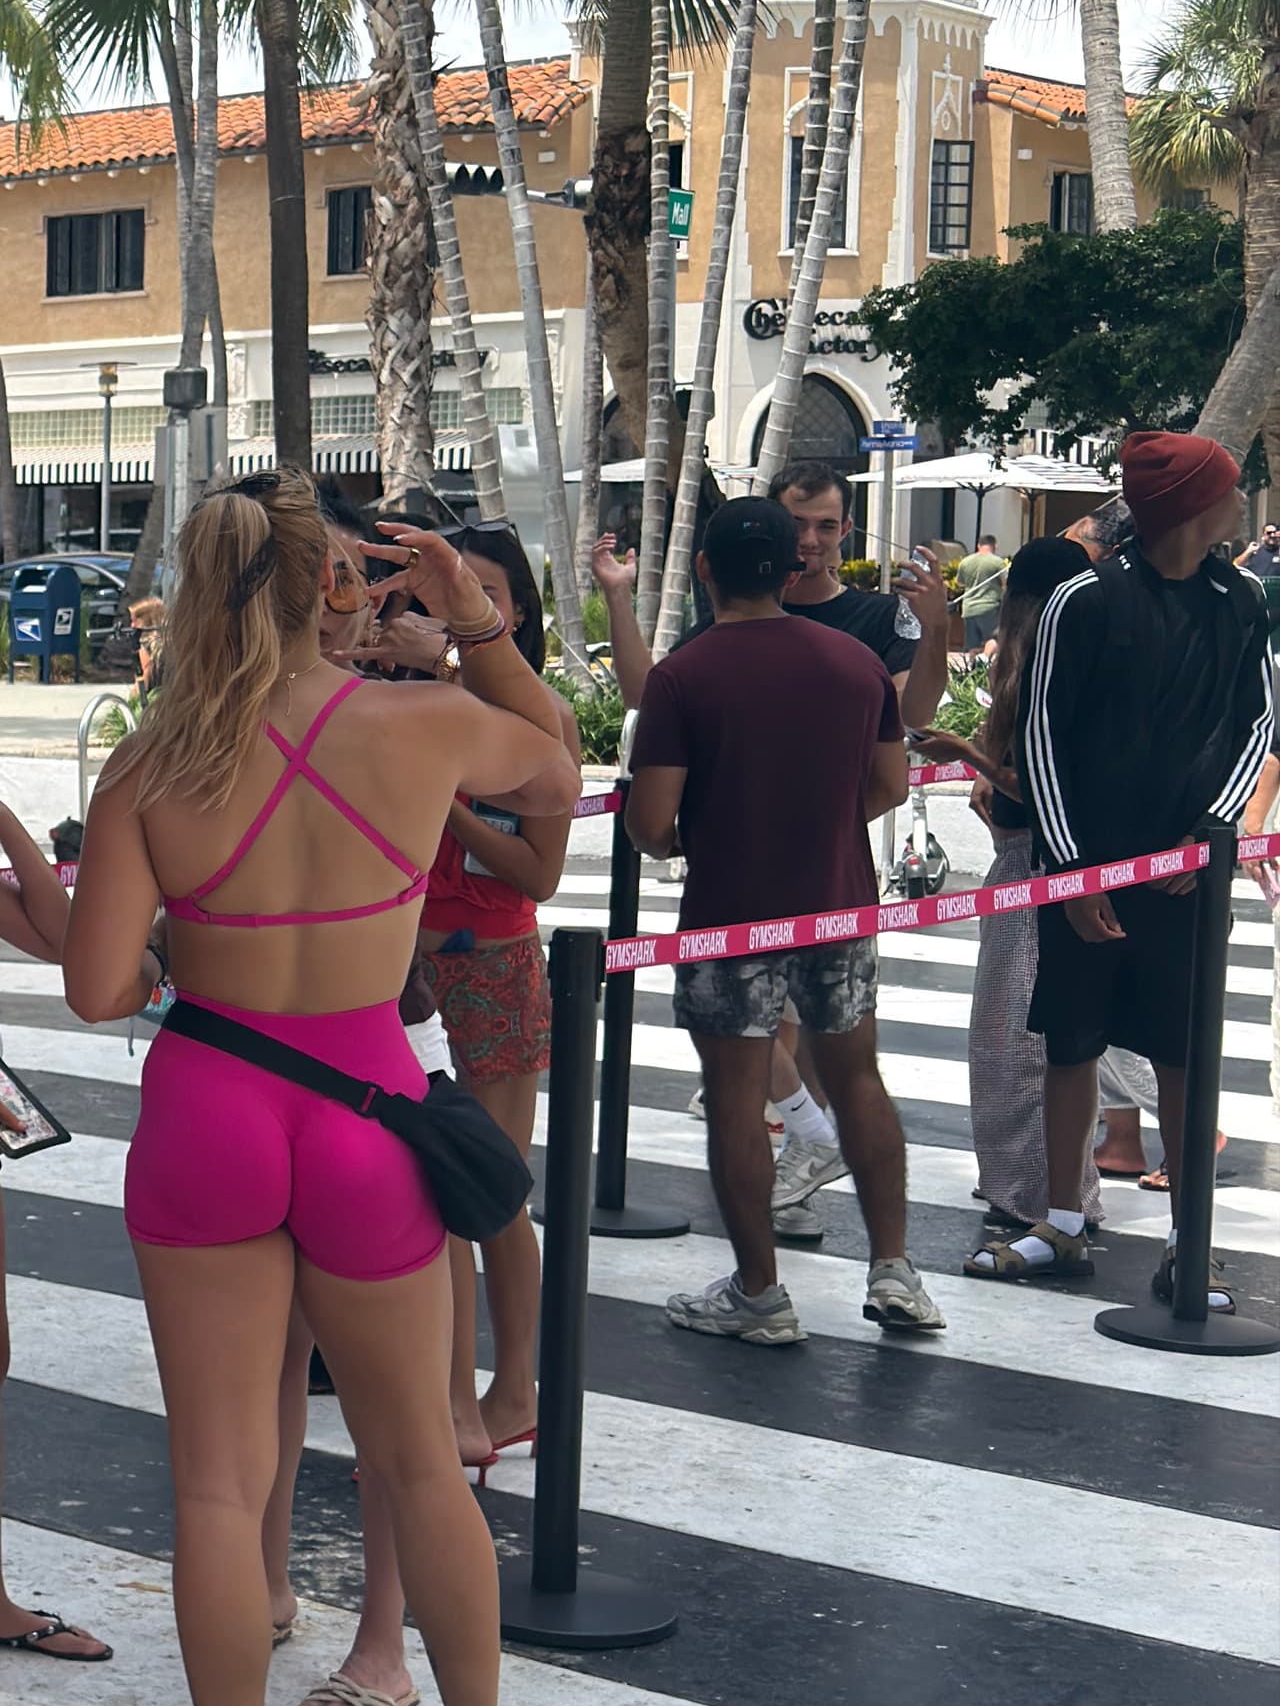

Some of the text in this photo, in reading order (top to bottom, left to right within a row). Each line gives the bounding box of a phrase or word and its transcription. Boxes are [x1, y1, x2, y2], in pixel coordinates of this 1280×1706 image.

[672, 201, 690, 226] Mall
[1238, 837, 1269, 859] GYMSHARK
[605, 939, 657, 970] GYMSHARK
[679, 931, 728, 959] GYMSHARK
[749, 921, 796, 950] GYMSHARK
[815, 912, 859, 940] GYMSHARK
[877, 903, 919, 931] GYMSHARK
[937, 893, 976, 921] GYMSHARK
[993, 883, 1032, 910] GYMSHARK
[1048, 873, 1084, 899] GYMSHARK
[1100, 862, 1136, 888] GYMSHARK
[1150, 850, 1185, 877] GYMSHARK
